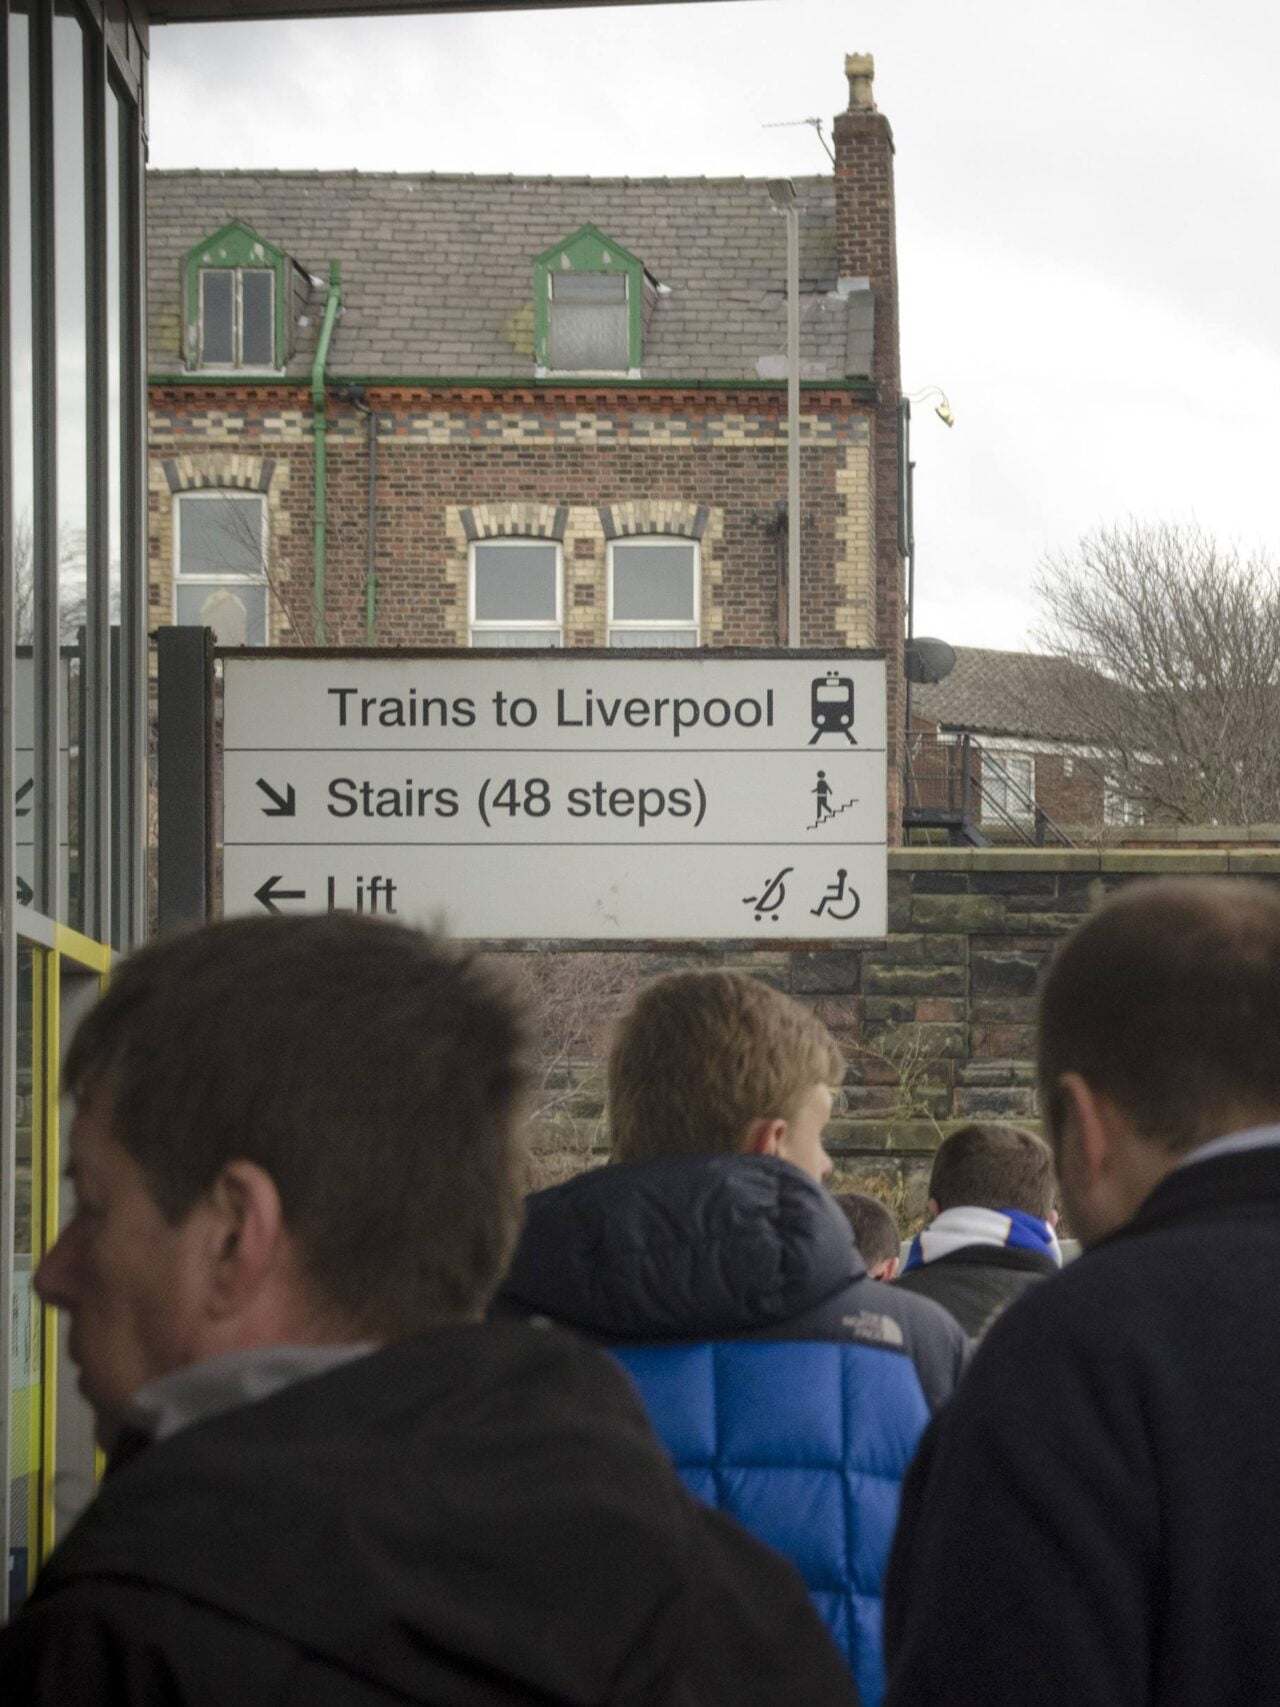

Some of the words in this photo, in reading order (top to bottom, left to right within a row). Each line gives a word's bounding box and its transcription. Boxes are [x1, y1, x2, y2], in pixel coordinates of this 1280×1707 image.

[327, 687, 476, 727] Trains
[492, 691, 538, 727] to
[557, 688, 774, 737] Liverpool
[327, 777, 459, 818] Stairs
[478, 778, 551, 828] (48
[567, 778, 707, 828] steps)
[327, 875, 397, 914] Lift
